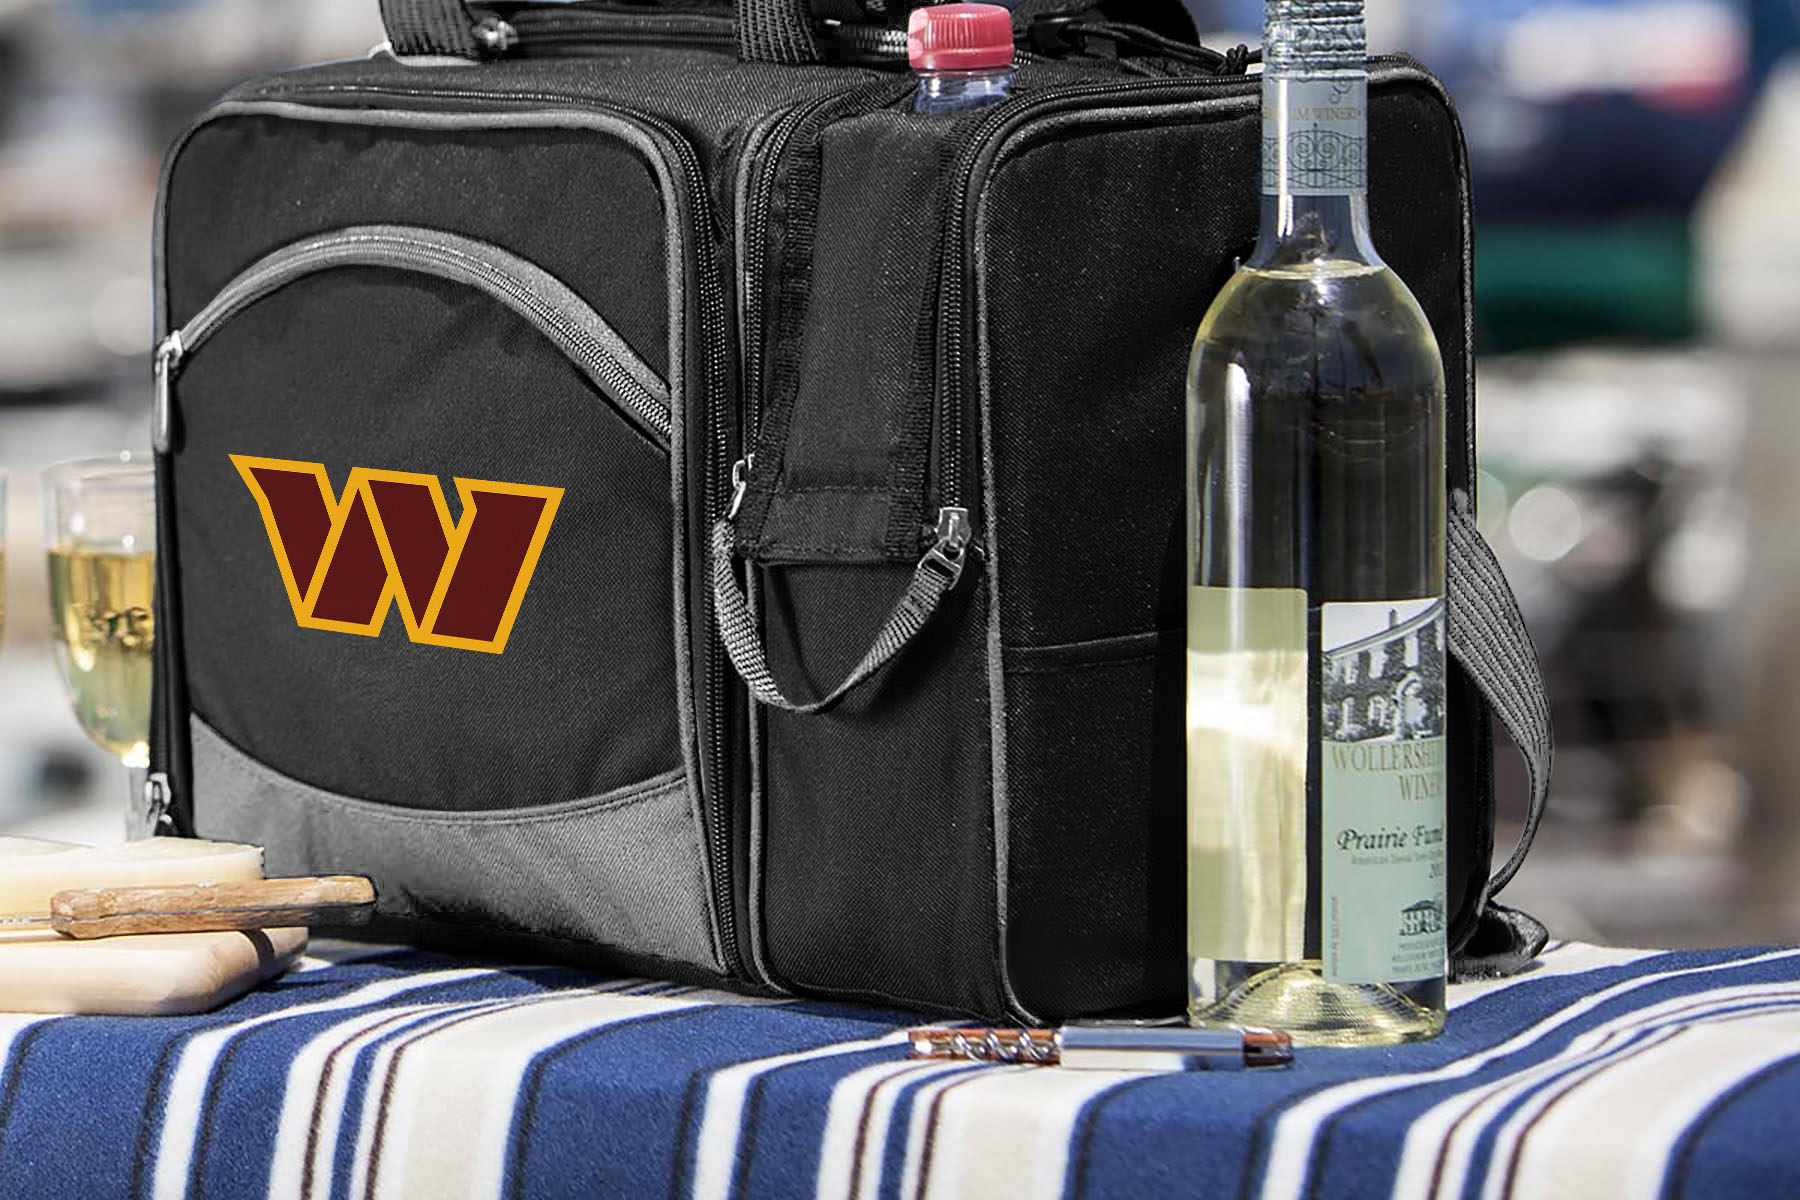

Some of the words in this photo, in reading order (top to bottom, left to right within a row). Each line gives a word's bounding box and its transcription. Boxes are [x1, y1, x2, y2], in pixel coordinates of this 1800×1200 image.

[227, 453, 565, 655] W
[1336, 825, 1409, 850] Prairie
[1411, 824, 1443, 848] Fum
